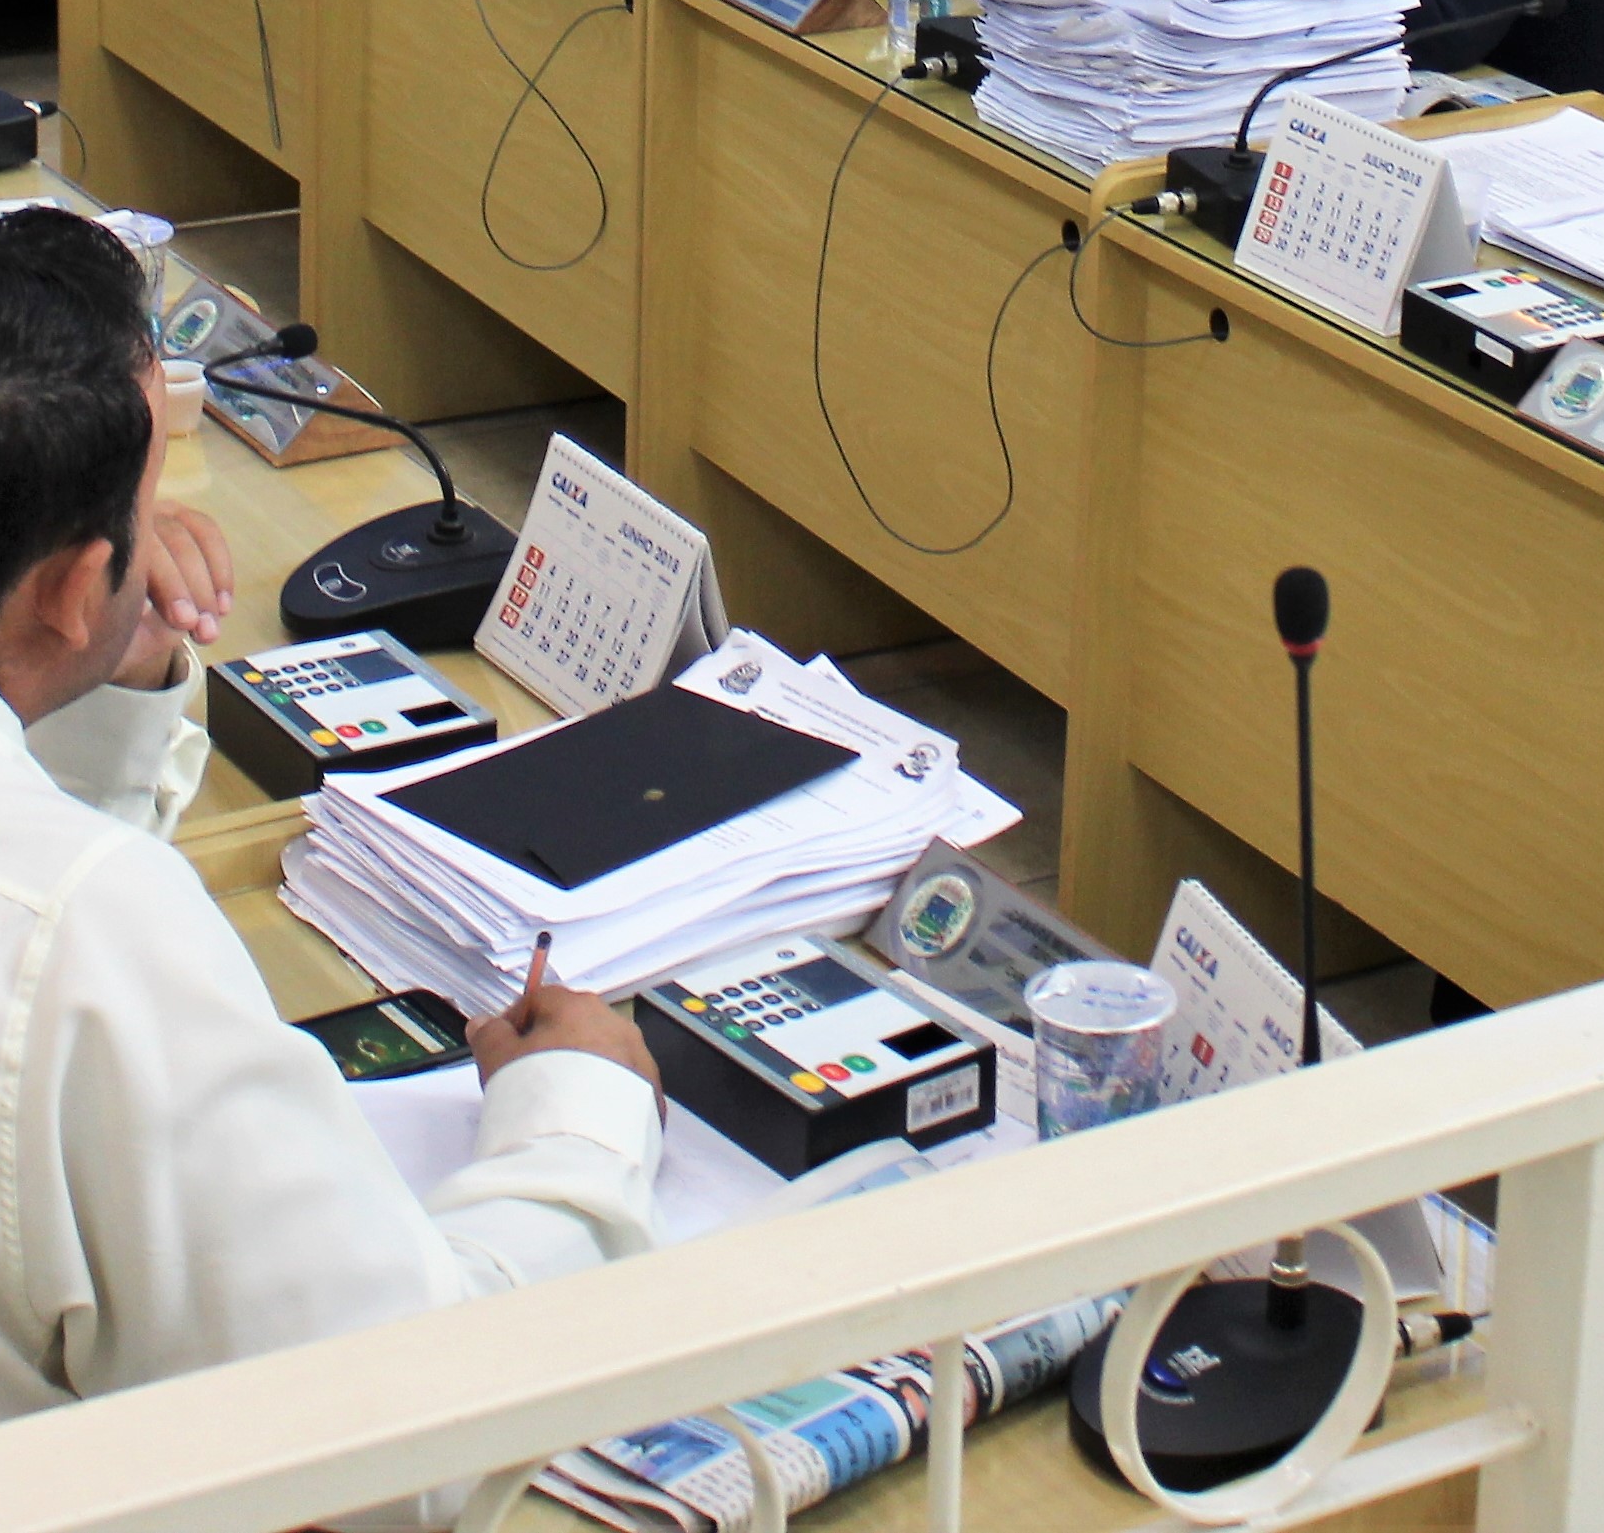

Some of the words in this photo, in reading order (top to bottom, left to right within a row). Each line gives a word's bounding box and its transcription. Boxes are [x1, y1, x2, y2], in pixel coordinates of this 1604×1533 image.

[1289, 118, 1327, 145] CAIXA
[1362, 152, 1395, 175] JULHO
[1396, 167, 1423, 188] 2018
[552, 471, 589, 509] CAIXA
[618, 520, 654, 555] JUNHO
[654, 546, 681, 575] 2018
[1176, 925, 1218, 980] CAIXA
[1262, 1015, 1295, 1057] MAIO
